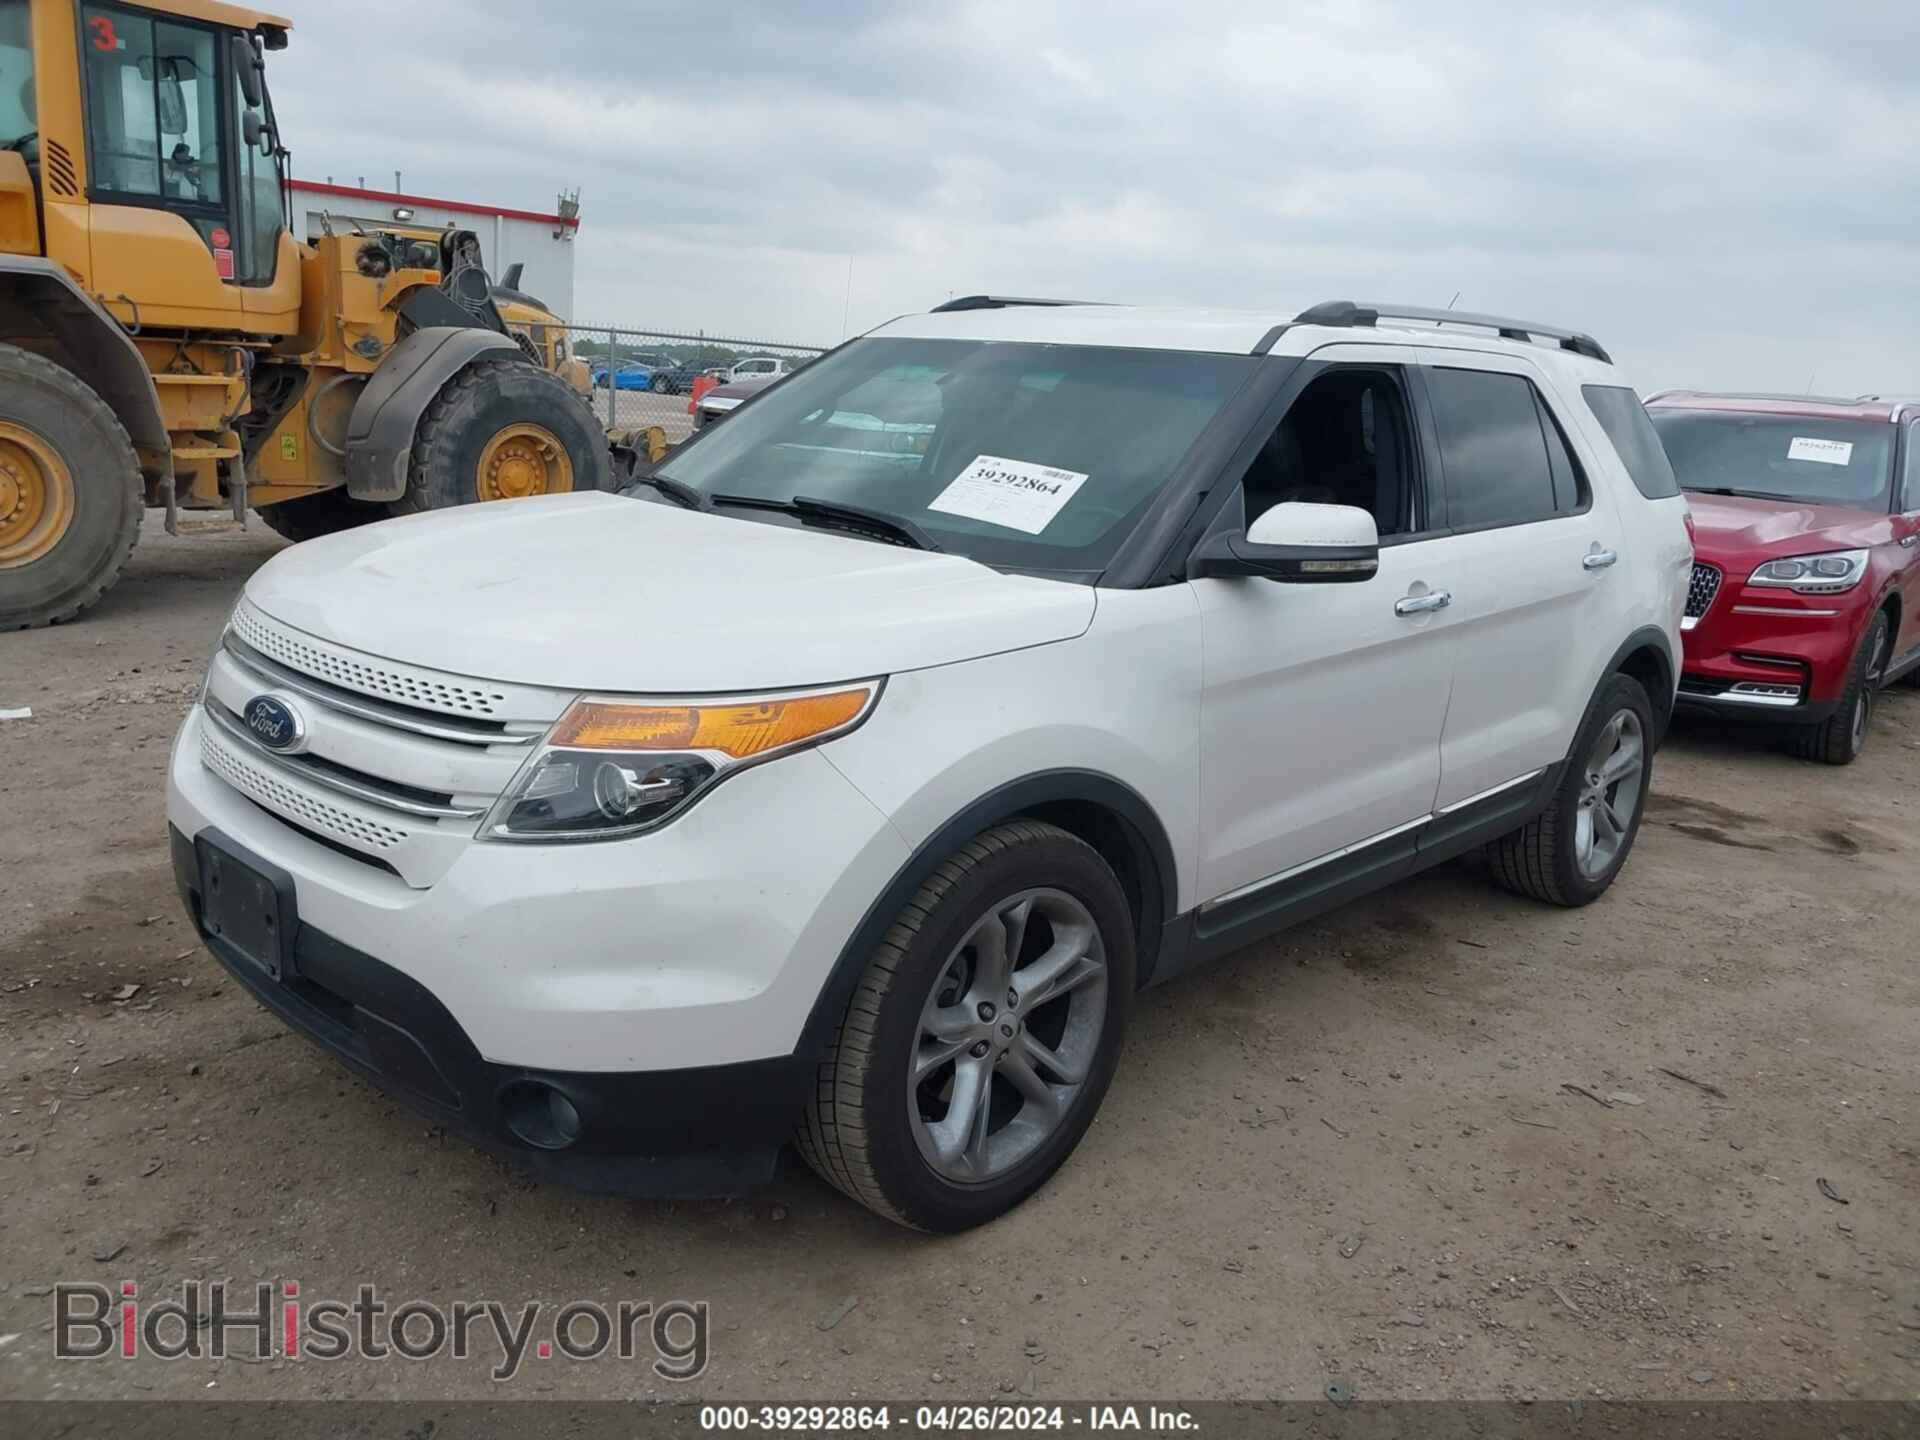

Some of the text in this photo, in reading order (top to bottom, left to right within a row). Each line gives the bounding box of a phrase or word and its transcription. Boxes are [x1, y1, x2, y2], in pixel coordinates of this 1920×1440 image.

[88, 16, 118, 51] 3
[970, 468, 1062, 495] 39292864
[250, 702, 283, 738] Ford
